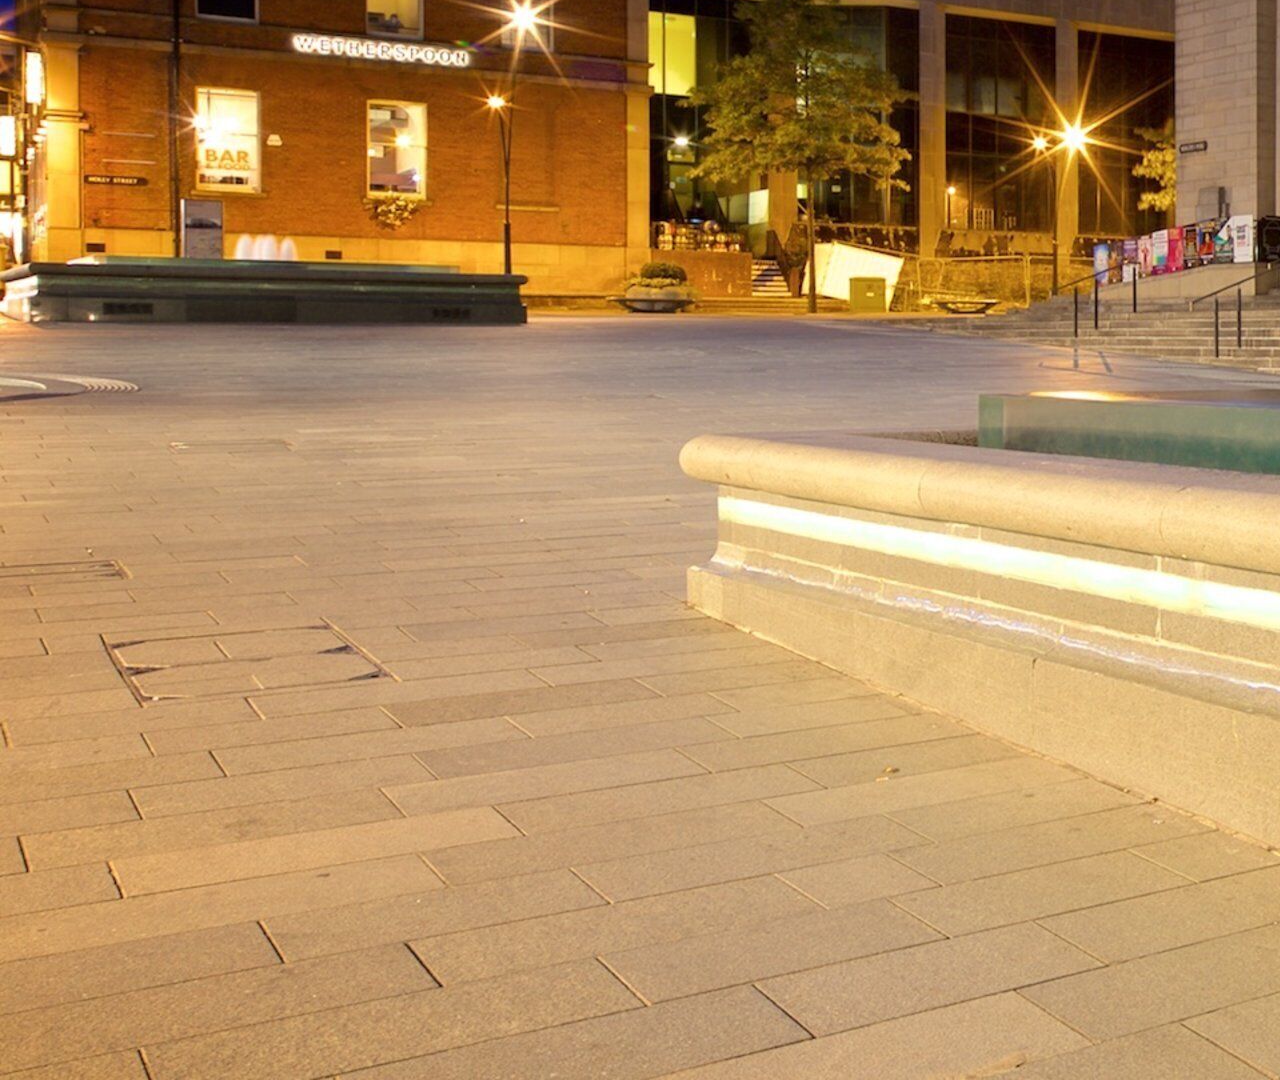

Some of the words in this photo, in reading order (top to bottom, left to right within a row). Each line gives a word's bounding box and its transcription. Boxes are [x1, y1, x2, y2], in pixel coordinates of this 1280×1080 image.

[294, 34, 470, 66] WETHERSPOON
[205, 149, 249, 163] BAR
[218, 162, 251, 171] FOOD
